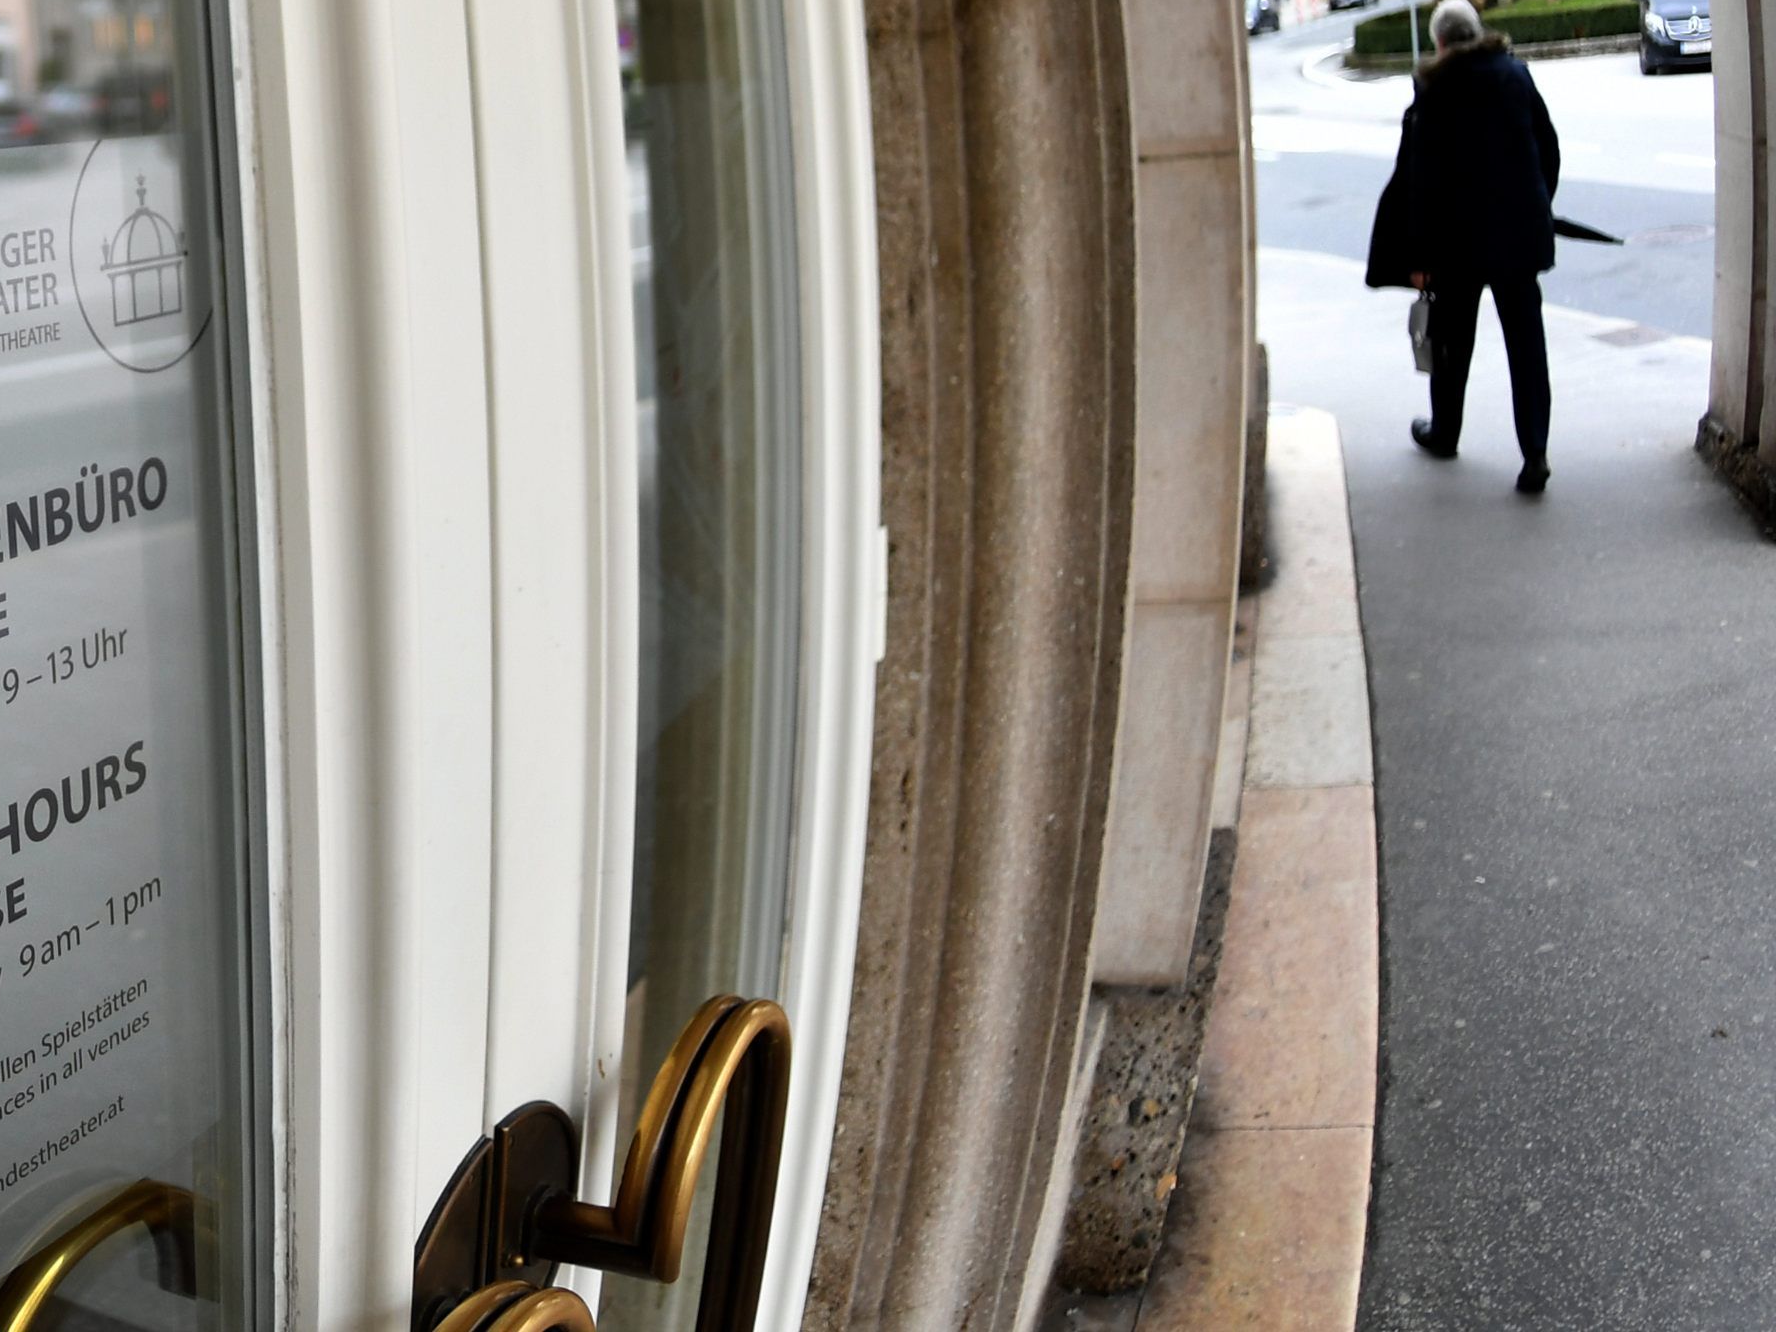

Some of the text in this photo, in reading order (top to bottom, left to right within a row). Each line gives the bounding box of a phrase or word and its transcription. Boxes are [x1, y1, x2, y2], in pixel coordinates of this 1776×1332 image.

[81, 627, 128, 669] Uhr
[39, 1069, 58, 1095] in
[62, 1049, 84, 1079] all
[87, 1010, 151, 1062] venues
[41, 977, 148, 1059] Spielstätten
